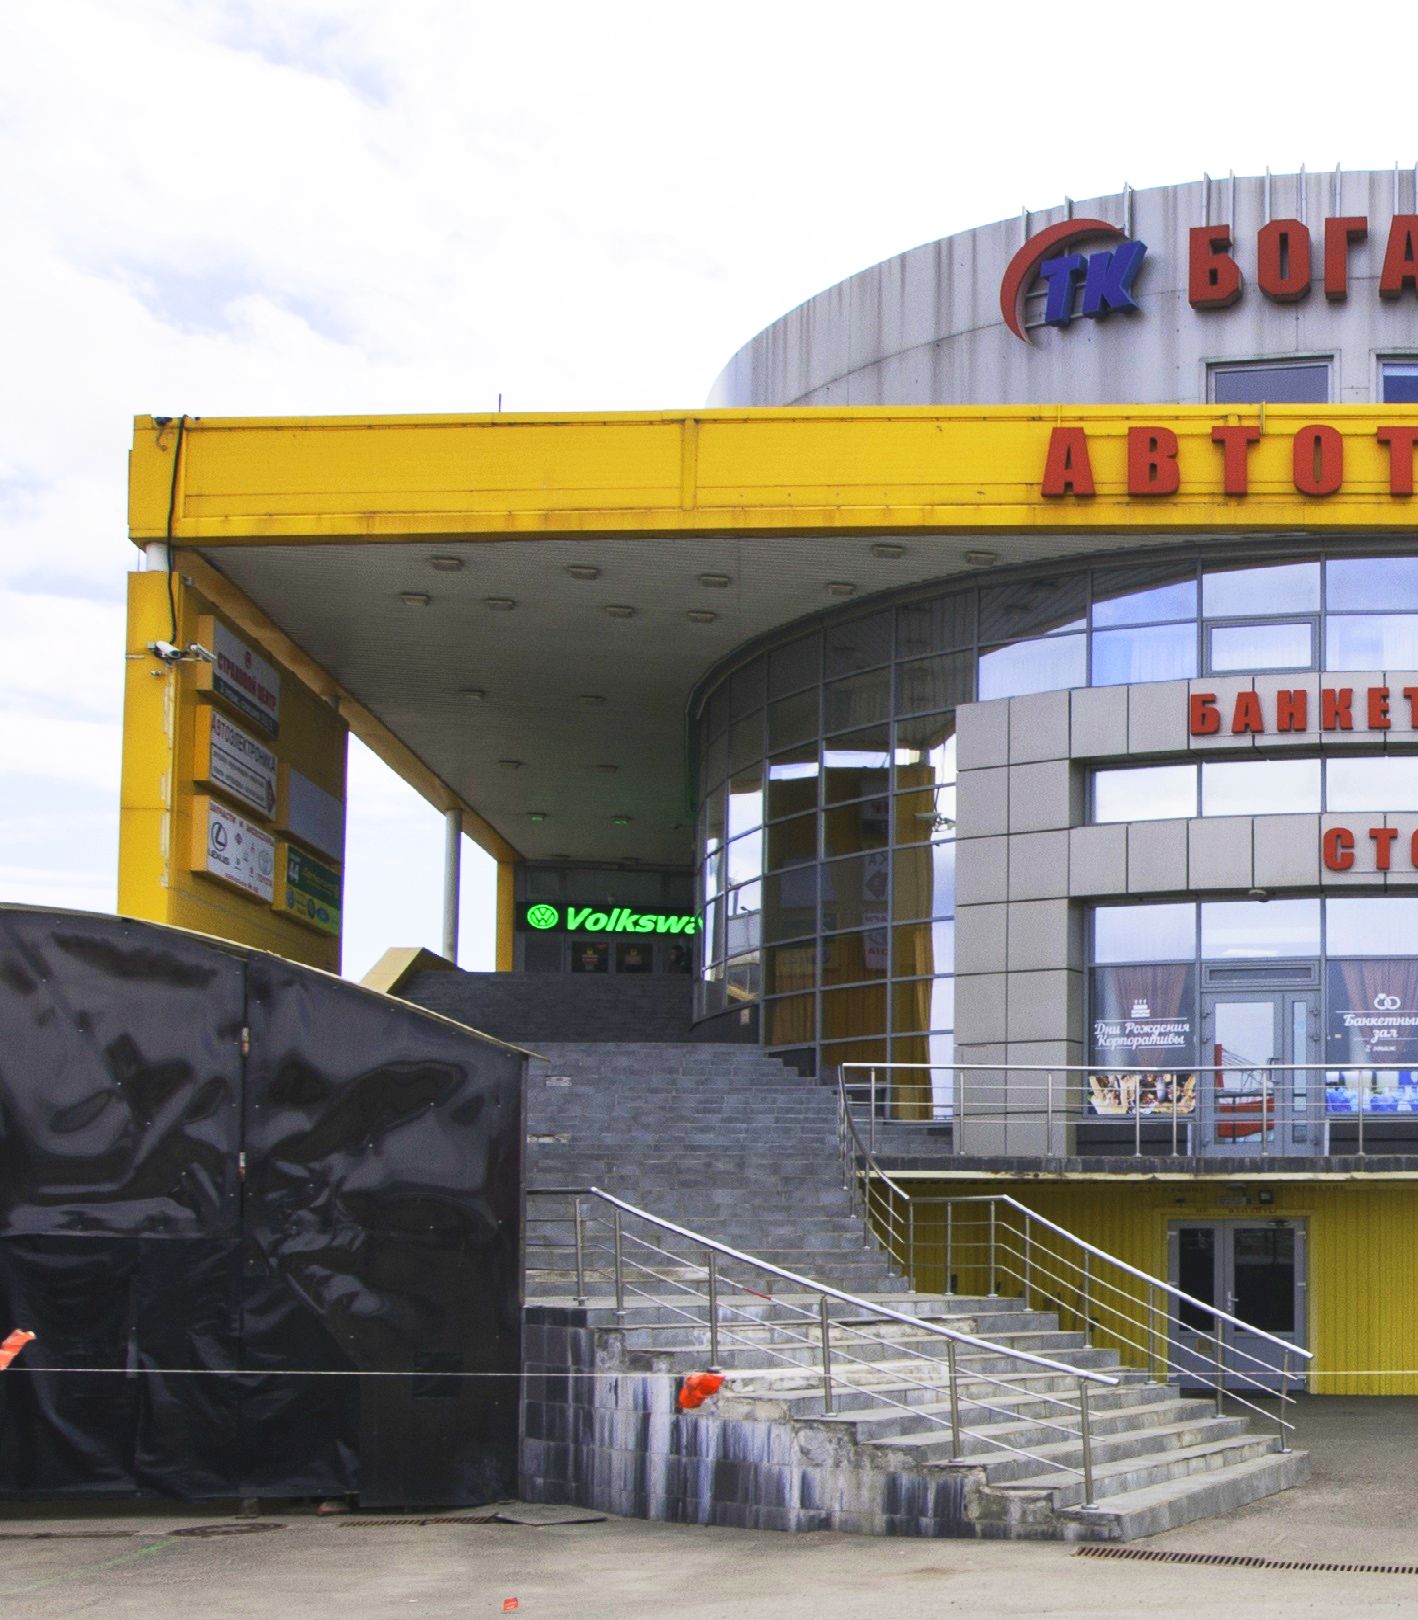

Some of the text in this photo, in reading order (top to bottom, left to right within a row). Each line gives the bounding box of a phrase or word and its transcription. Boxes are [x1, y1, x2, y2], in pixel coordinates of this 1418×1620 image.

[1094, 1022, 1191, 1037] Дни Рождения
[1370, 1029, 1399, 1044] зал
[1096, 1033, 1185, 1050] Корпоративы
